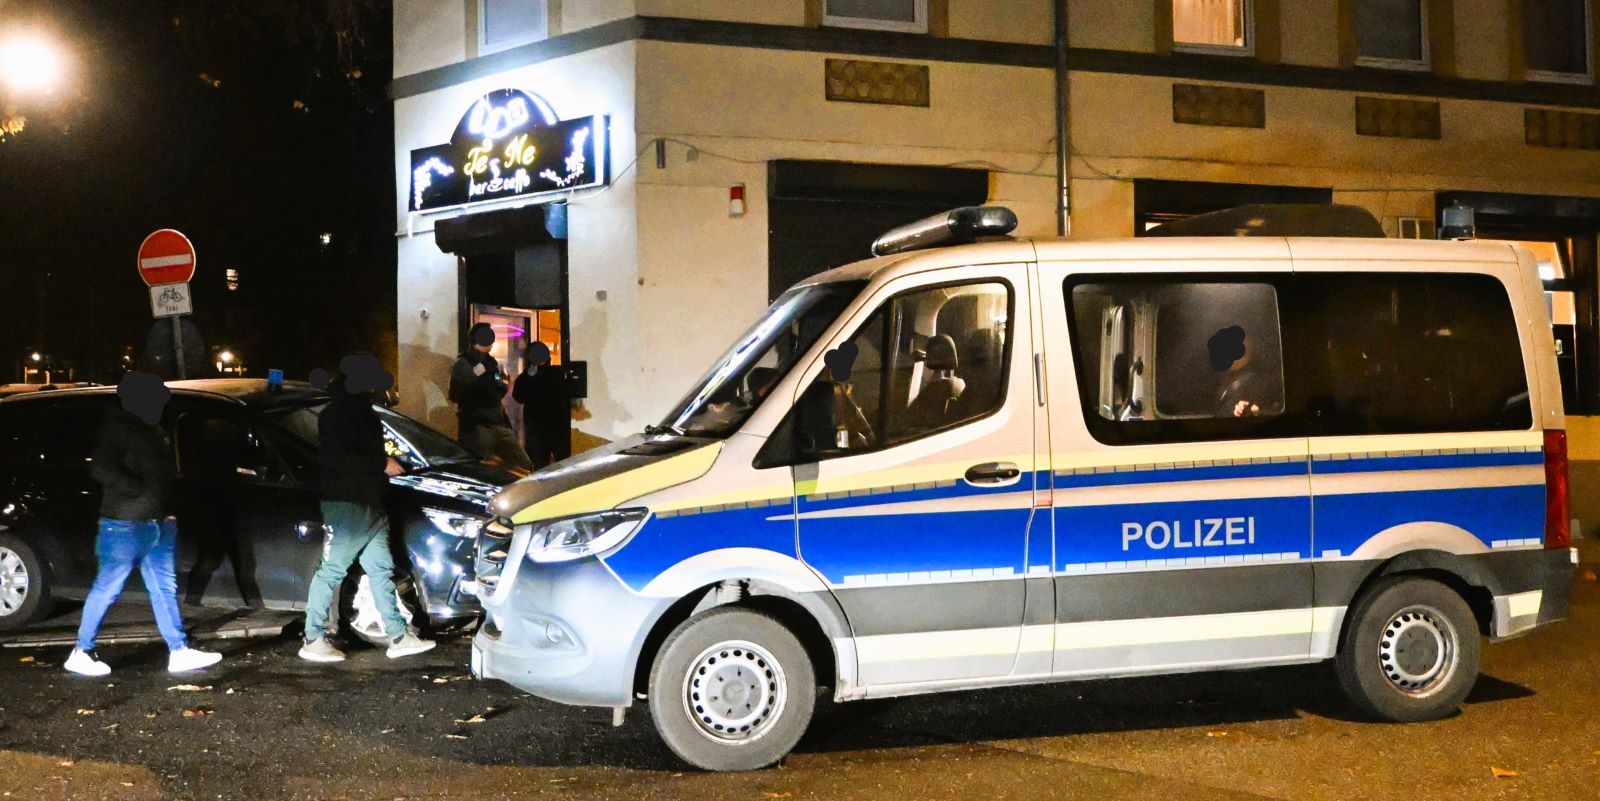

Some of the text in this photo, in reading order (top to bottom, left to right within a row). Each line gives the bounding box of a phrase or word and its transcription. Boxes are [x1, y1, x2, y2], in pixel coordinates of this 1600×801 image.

[464, 133, 536, 176] Te Ne
[1122, 516, 1255, 551] POLIZEI
